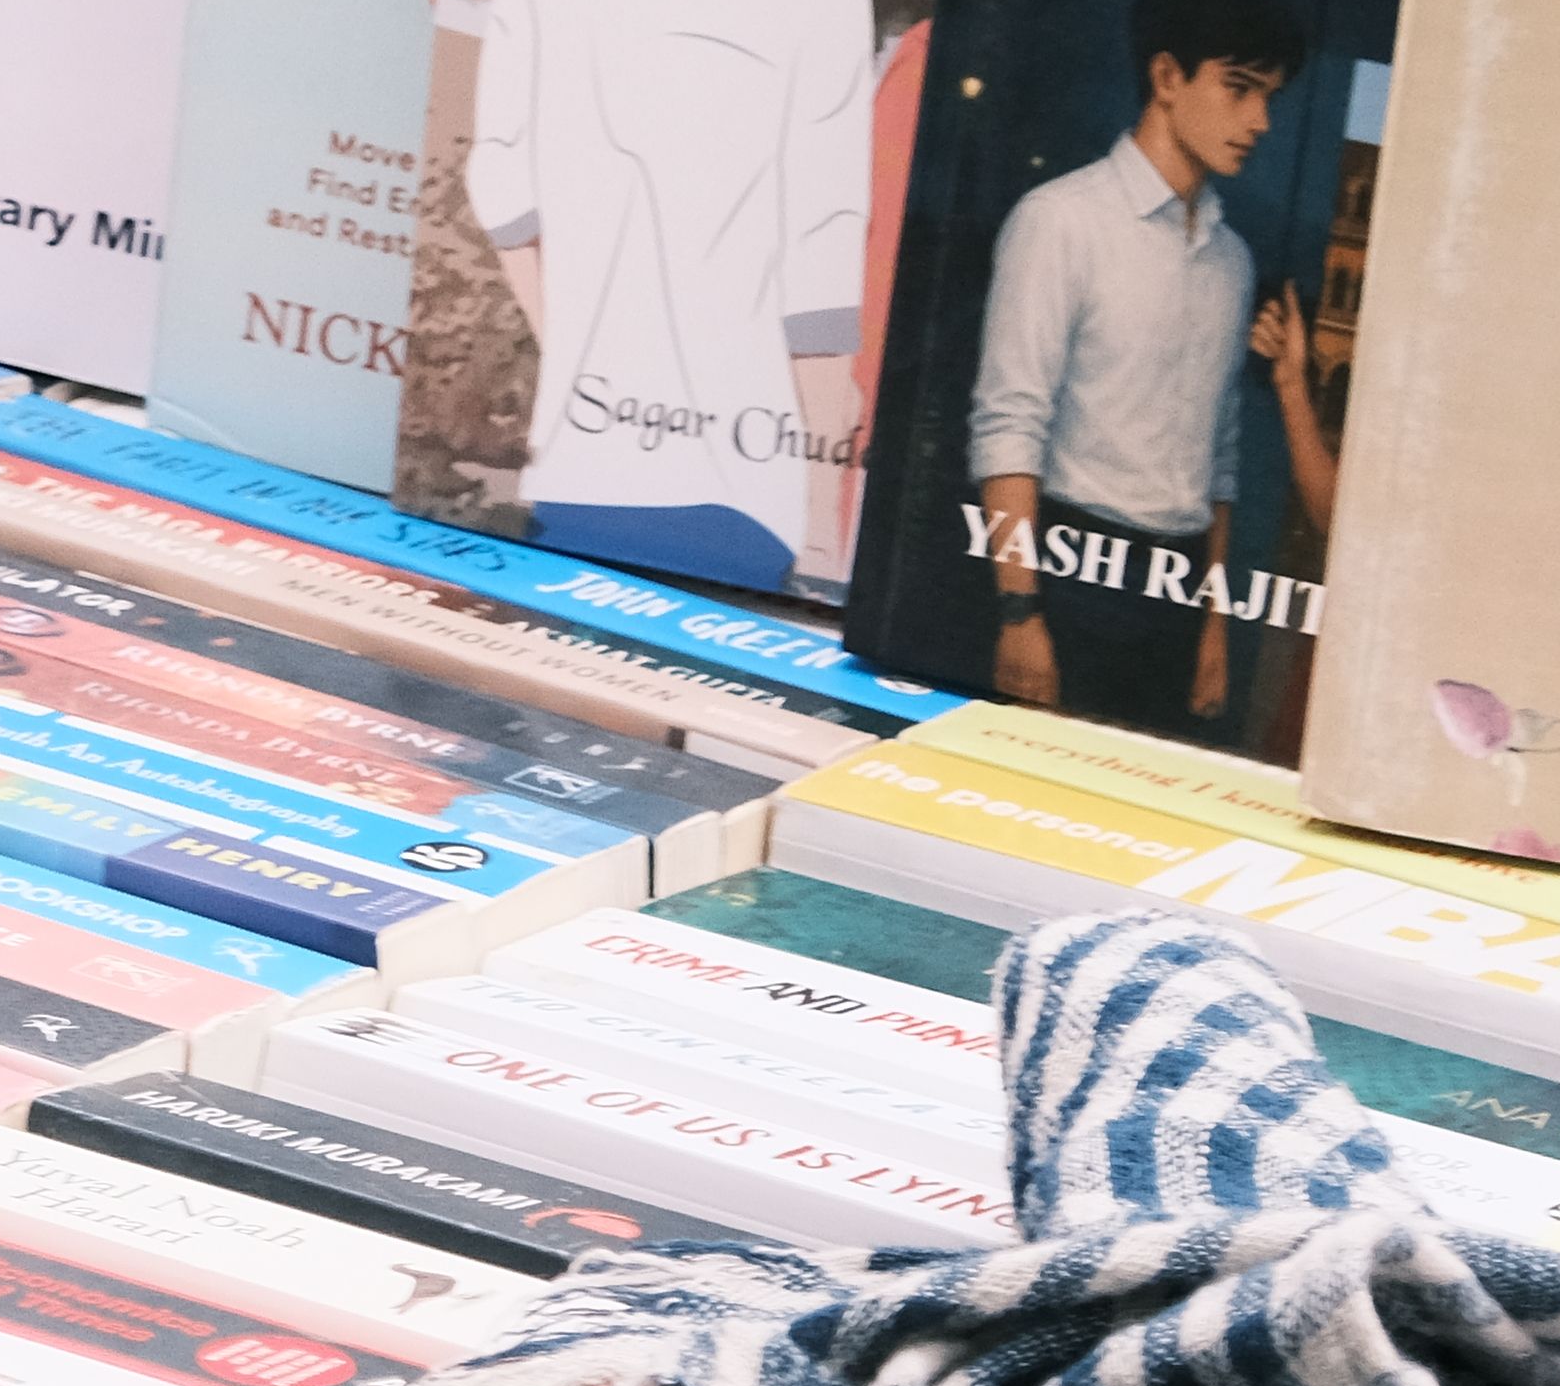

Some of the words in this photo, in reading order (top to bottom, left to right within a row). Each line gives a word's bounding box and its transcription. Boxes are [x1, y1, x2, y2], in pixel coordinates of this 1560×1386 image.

[266, 206, 328, 239] and
[307, 166, 378, 205] Find
[563, 373, 718, 452] Sagar
[960, 502, 1130, 592] YASH
[534, 569, 686, 618] JOHN
[934, 785, 1198, 866] personal
[164, 832, 374, 901] HENRY
[581, 931, 758, 989] CRIME
[743, 976, 869, 1017] AND
[445, 1048, 587, 1096] ONE
[584, 1087, 685, 1118] OF
[672, 1110, 774, 1150] US
[773, 1139, 856, 1173] IS
[121, 1089, 298, 1145] HARUKI
[288, 1137, 544, 1213] MURAKAMI
[11, 1186, 203, 1248] Harari
[158, 1191, 313, 1253] Noah
